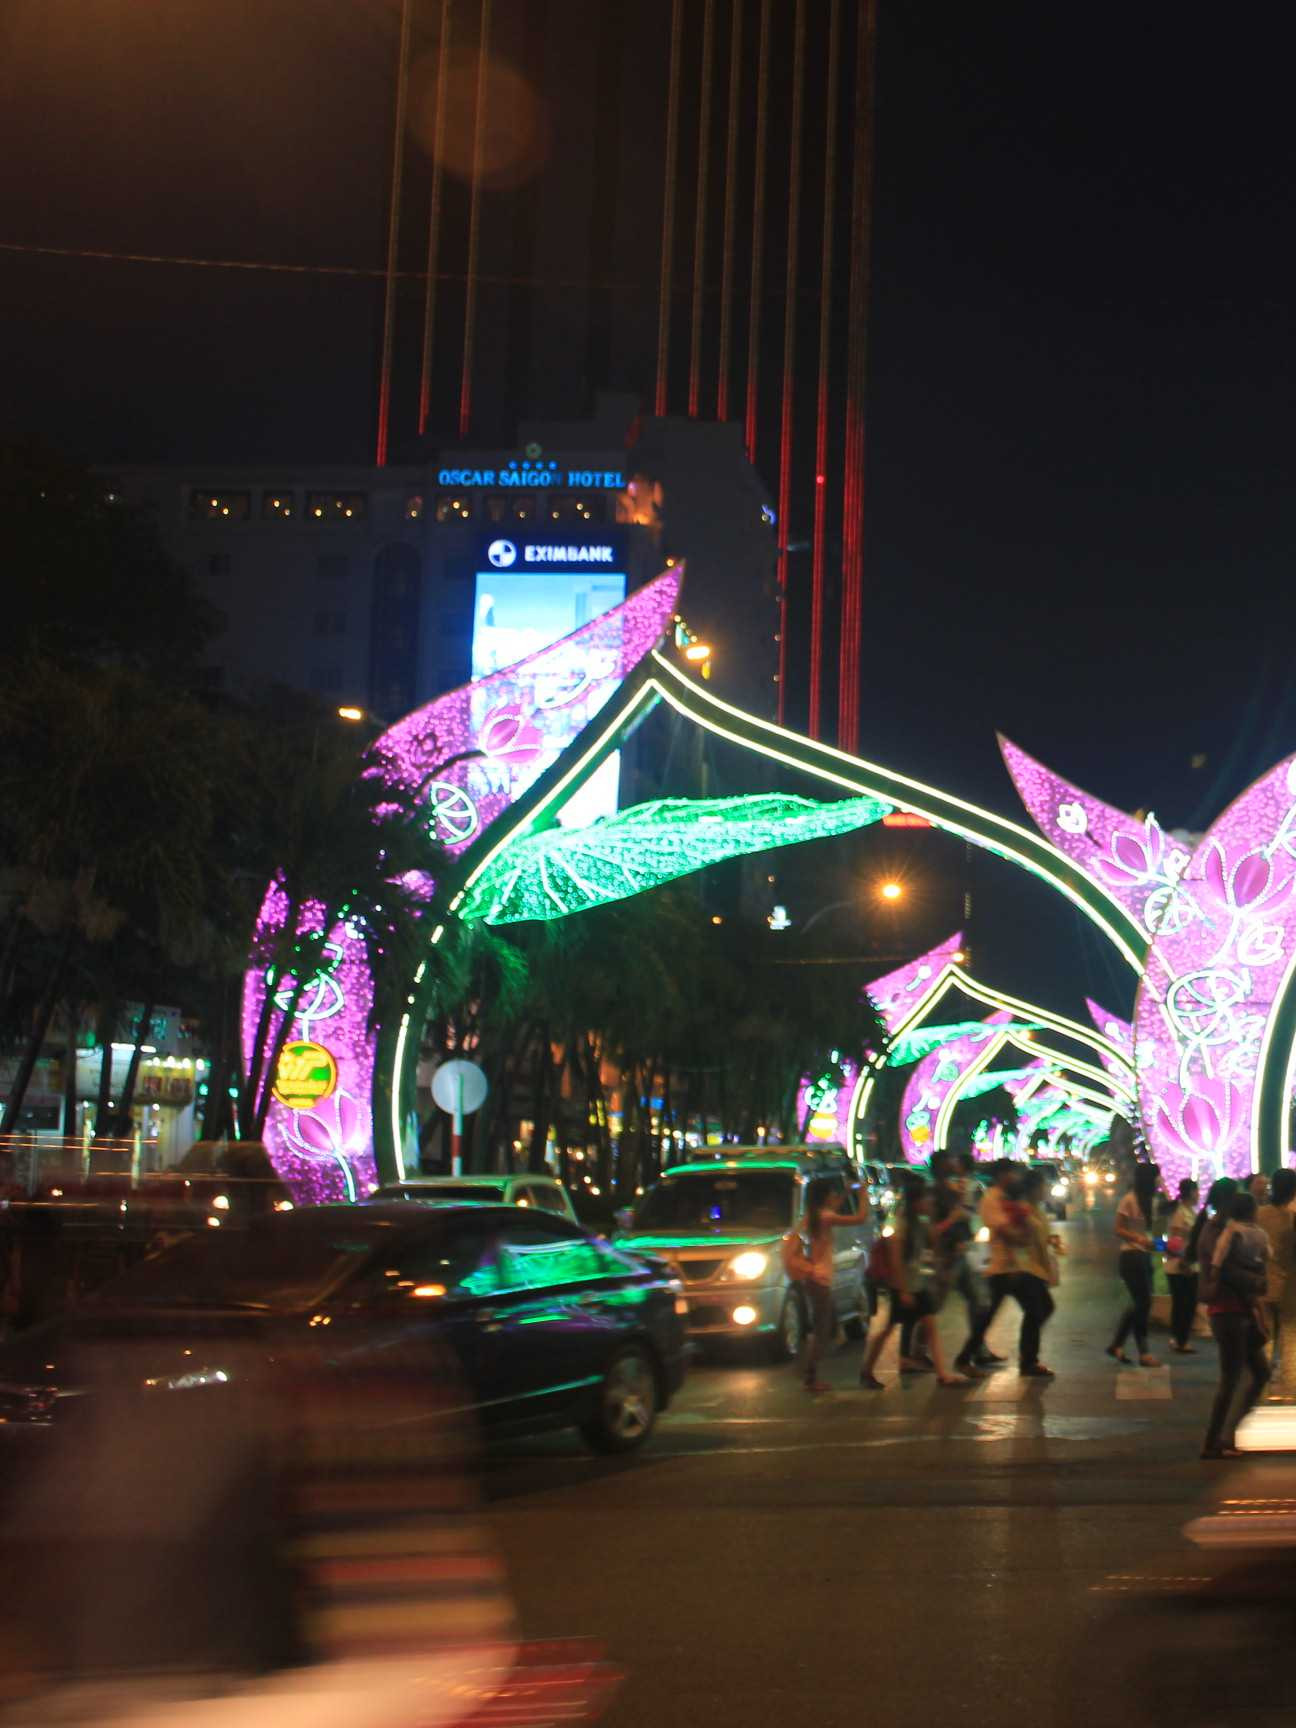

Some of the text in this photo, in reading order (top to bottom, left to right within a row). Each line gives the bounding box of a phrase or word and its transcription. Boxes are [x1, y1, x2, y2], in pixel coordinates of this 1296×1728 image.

[437, 469, 496, 487] OSCAR
[567, 470, 626, 488] HOTEL
[524, 544, 614, 562] EXIMBANK
